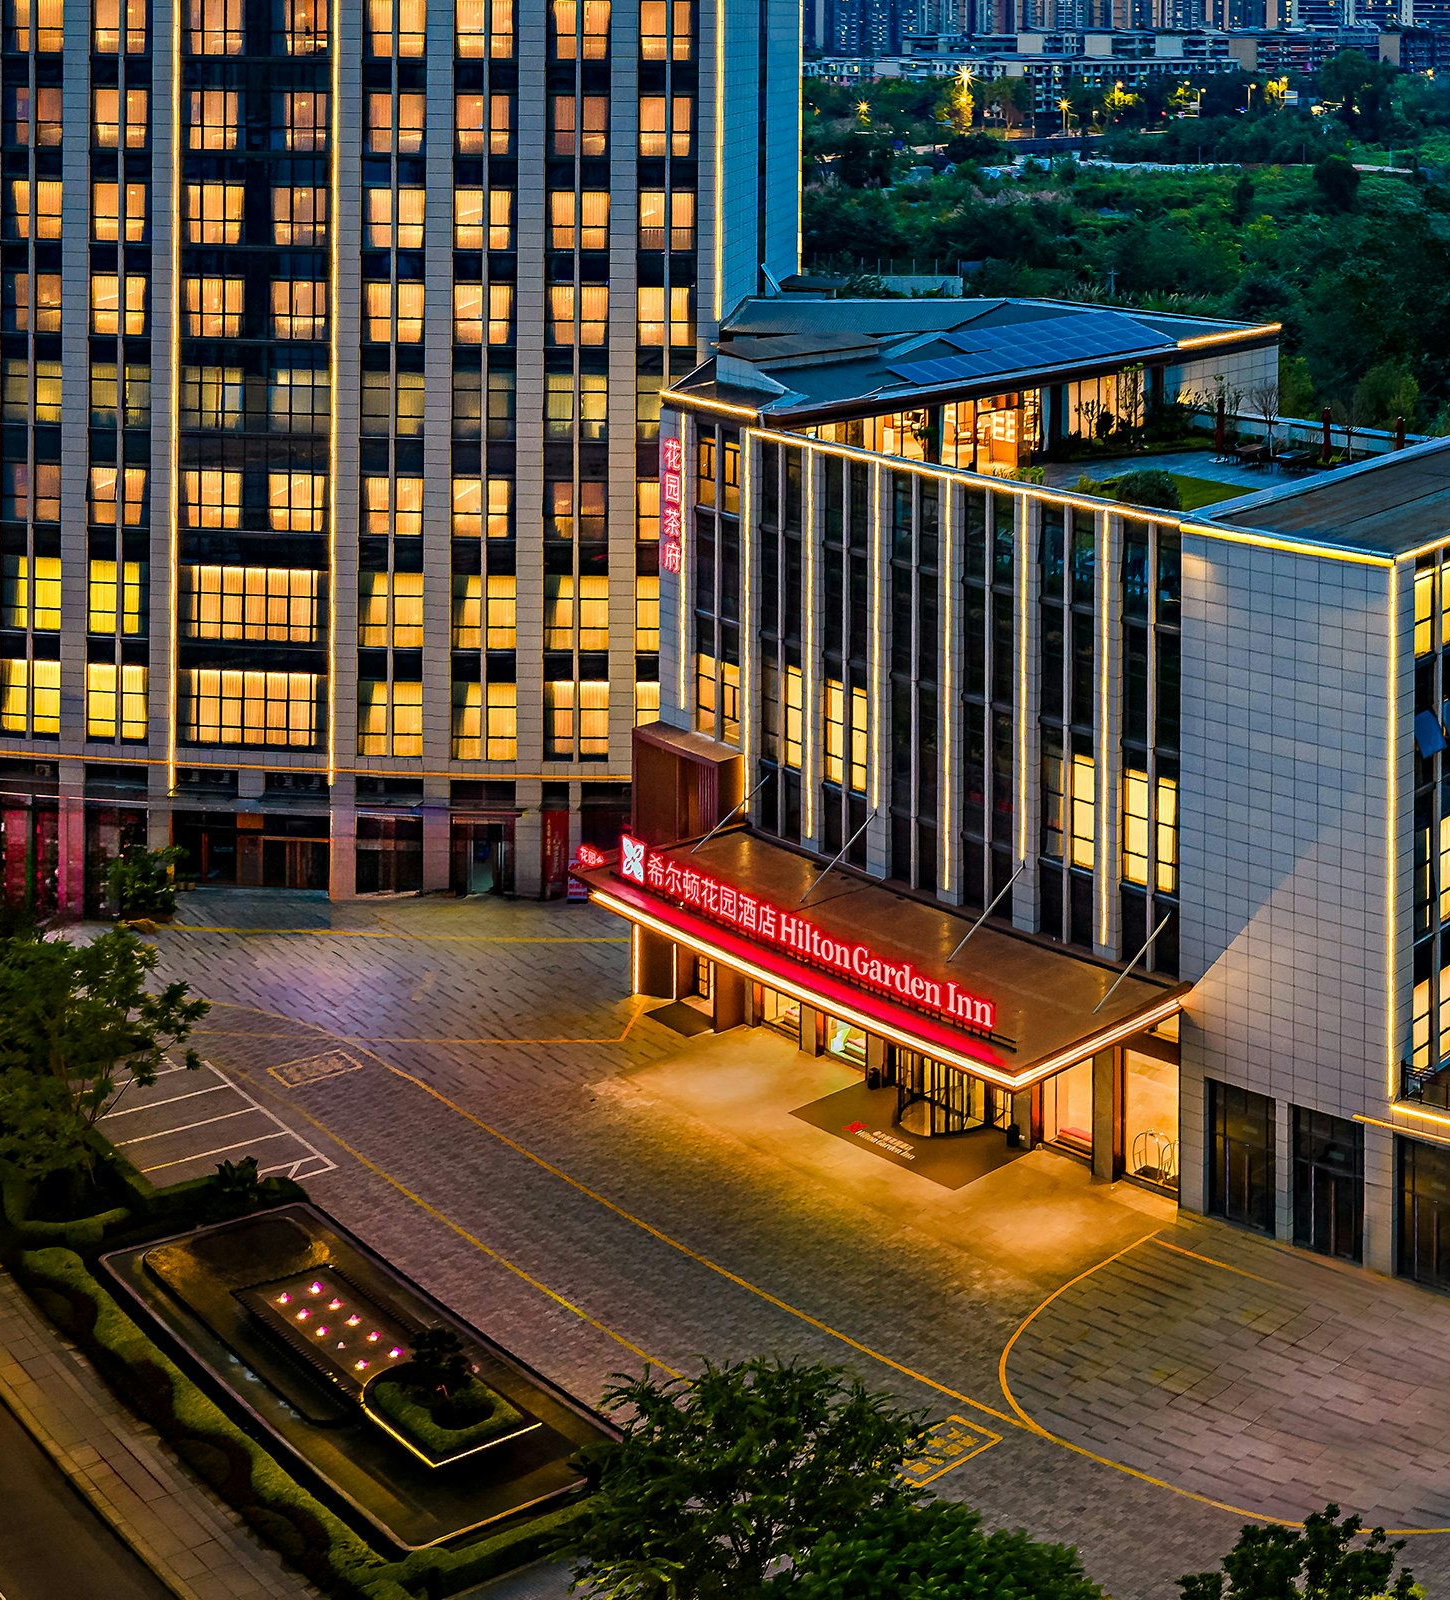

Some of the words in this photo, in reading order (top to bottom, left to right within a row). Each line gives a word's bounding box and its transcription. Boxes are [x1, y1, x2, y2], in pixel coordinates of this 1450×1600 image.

[664, 439, 682, 574] 花园茶府
[647, 852, 777, 939] 希尔顿花园酒店
[779, 912, 852, 970] Hilton
[852, 946, 943, 1007] Garden
[945, 980, 994, 1028] Inn
